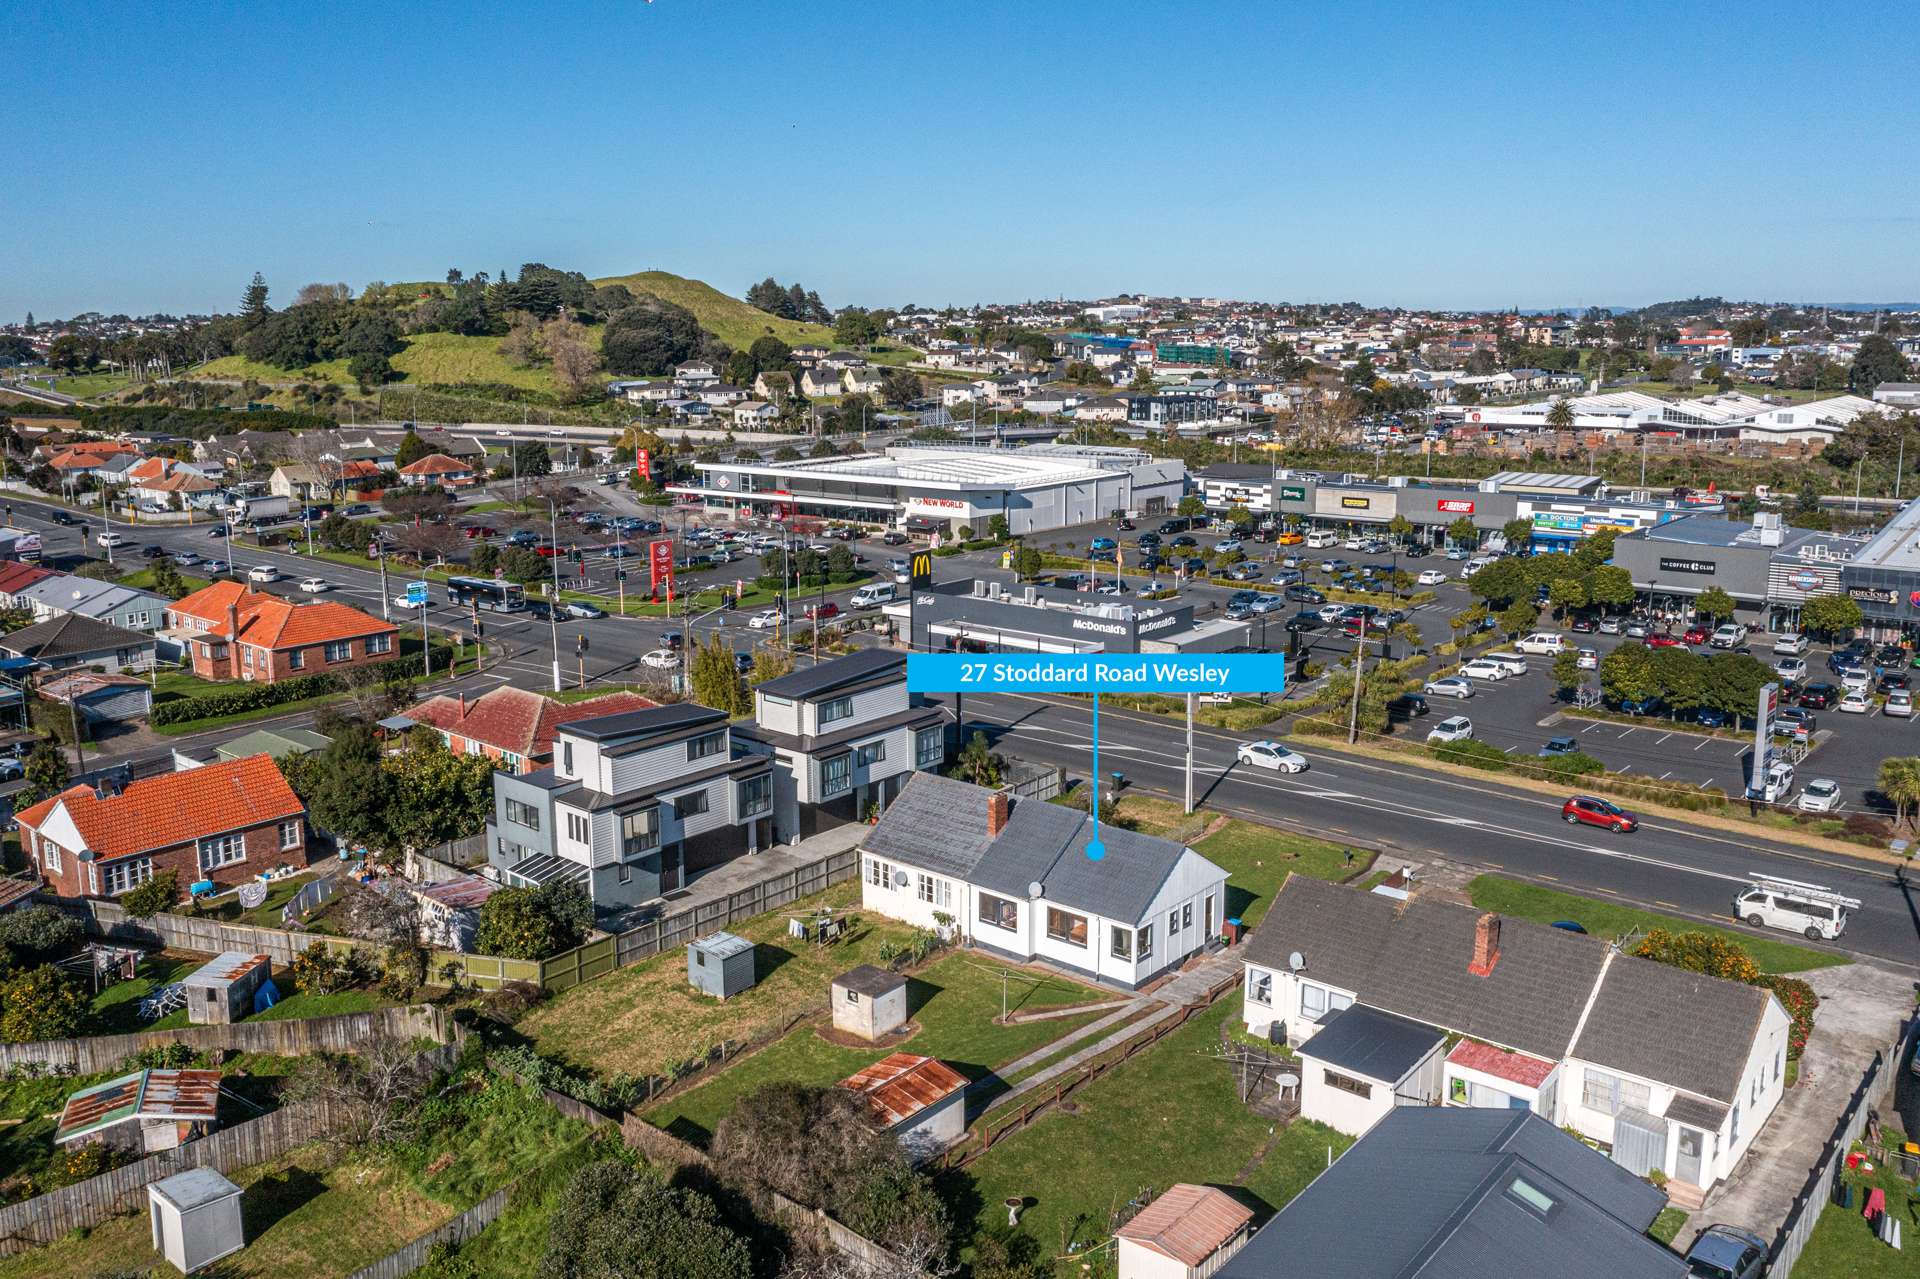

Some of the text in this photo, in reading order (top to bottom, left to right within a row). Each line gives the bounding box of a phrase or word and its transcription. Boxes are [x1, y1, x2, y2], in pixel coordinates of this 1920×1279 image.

[1550, 514, 1578, 522] DOCTORS
[1072, 619, 1127, 636] McDonald's
[1138, 616, 1177, 635] McDonald's
